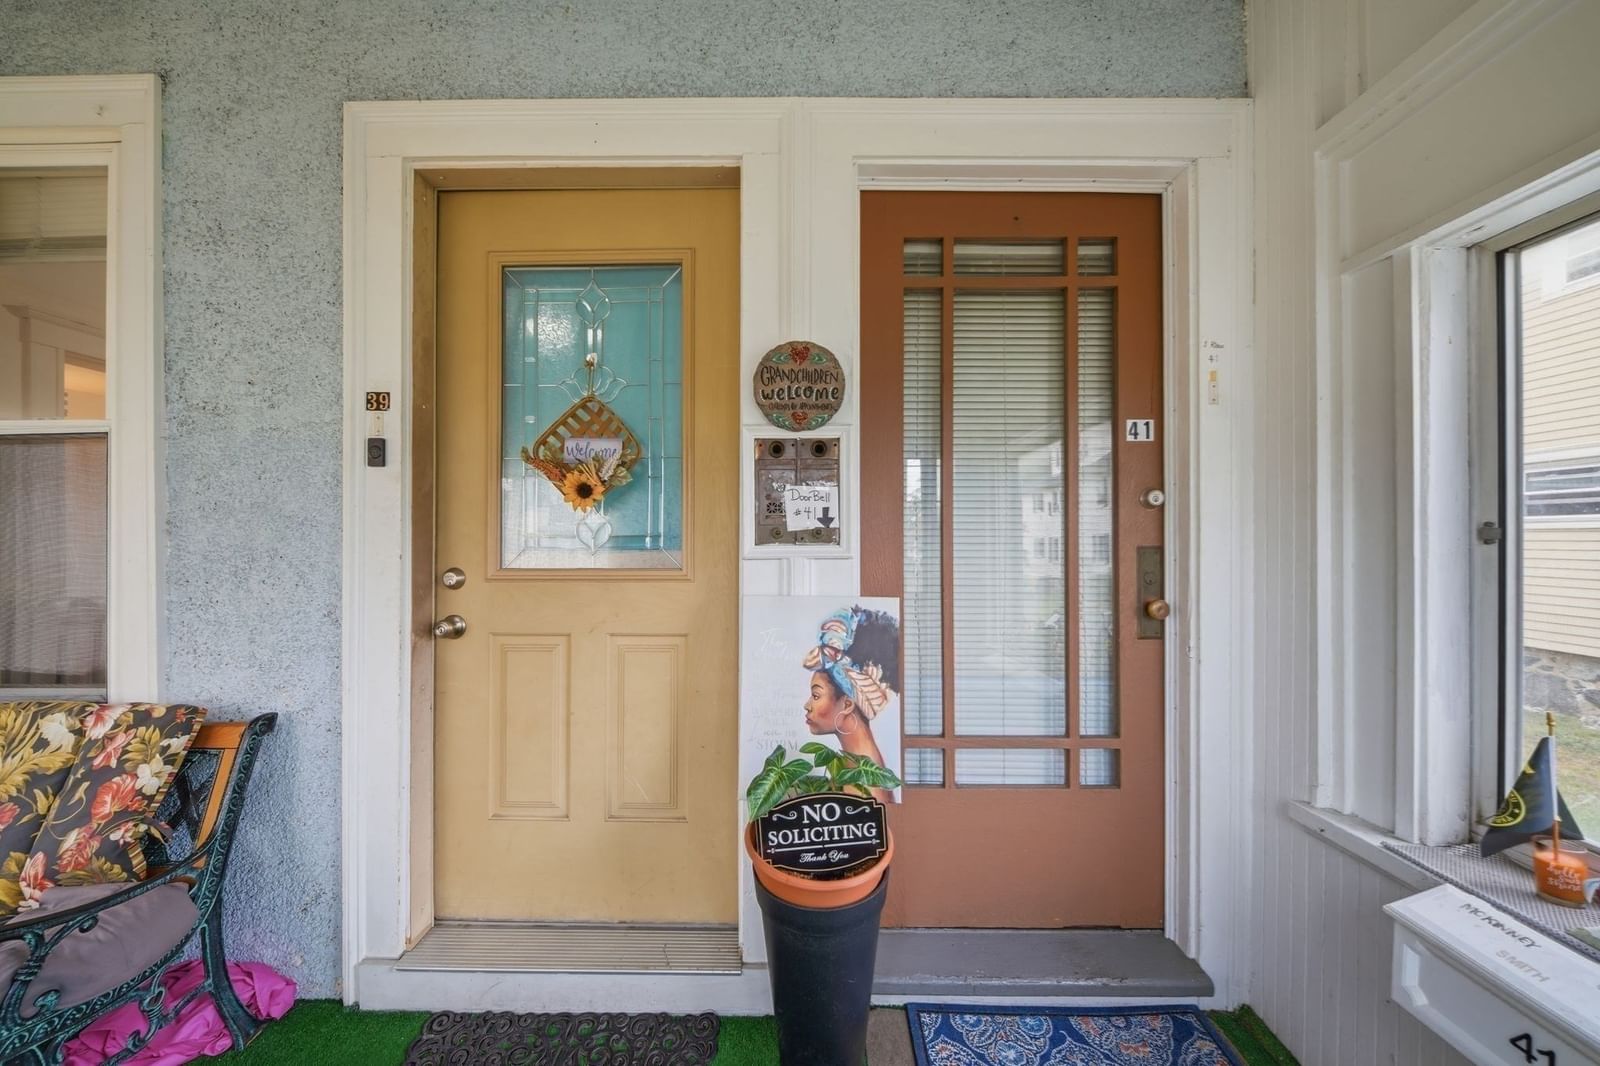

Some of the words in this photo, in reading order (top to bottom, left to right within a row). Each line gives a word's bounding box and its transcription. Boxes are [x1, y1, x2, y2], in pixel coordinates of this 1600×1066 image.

[760, 365, 839, 387] GRANDCHILDREN
[367, 392, 389, 410] 39
[1128, 421, 1150, 440] 41
[801, 802, 841, 824] NO
[767, 822, 877, 846] SOLICITING
[799, 852, 827, 863] Thank
[828, 849, 849, 863] You
[1495, 950, 1551, 983] SMITH
